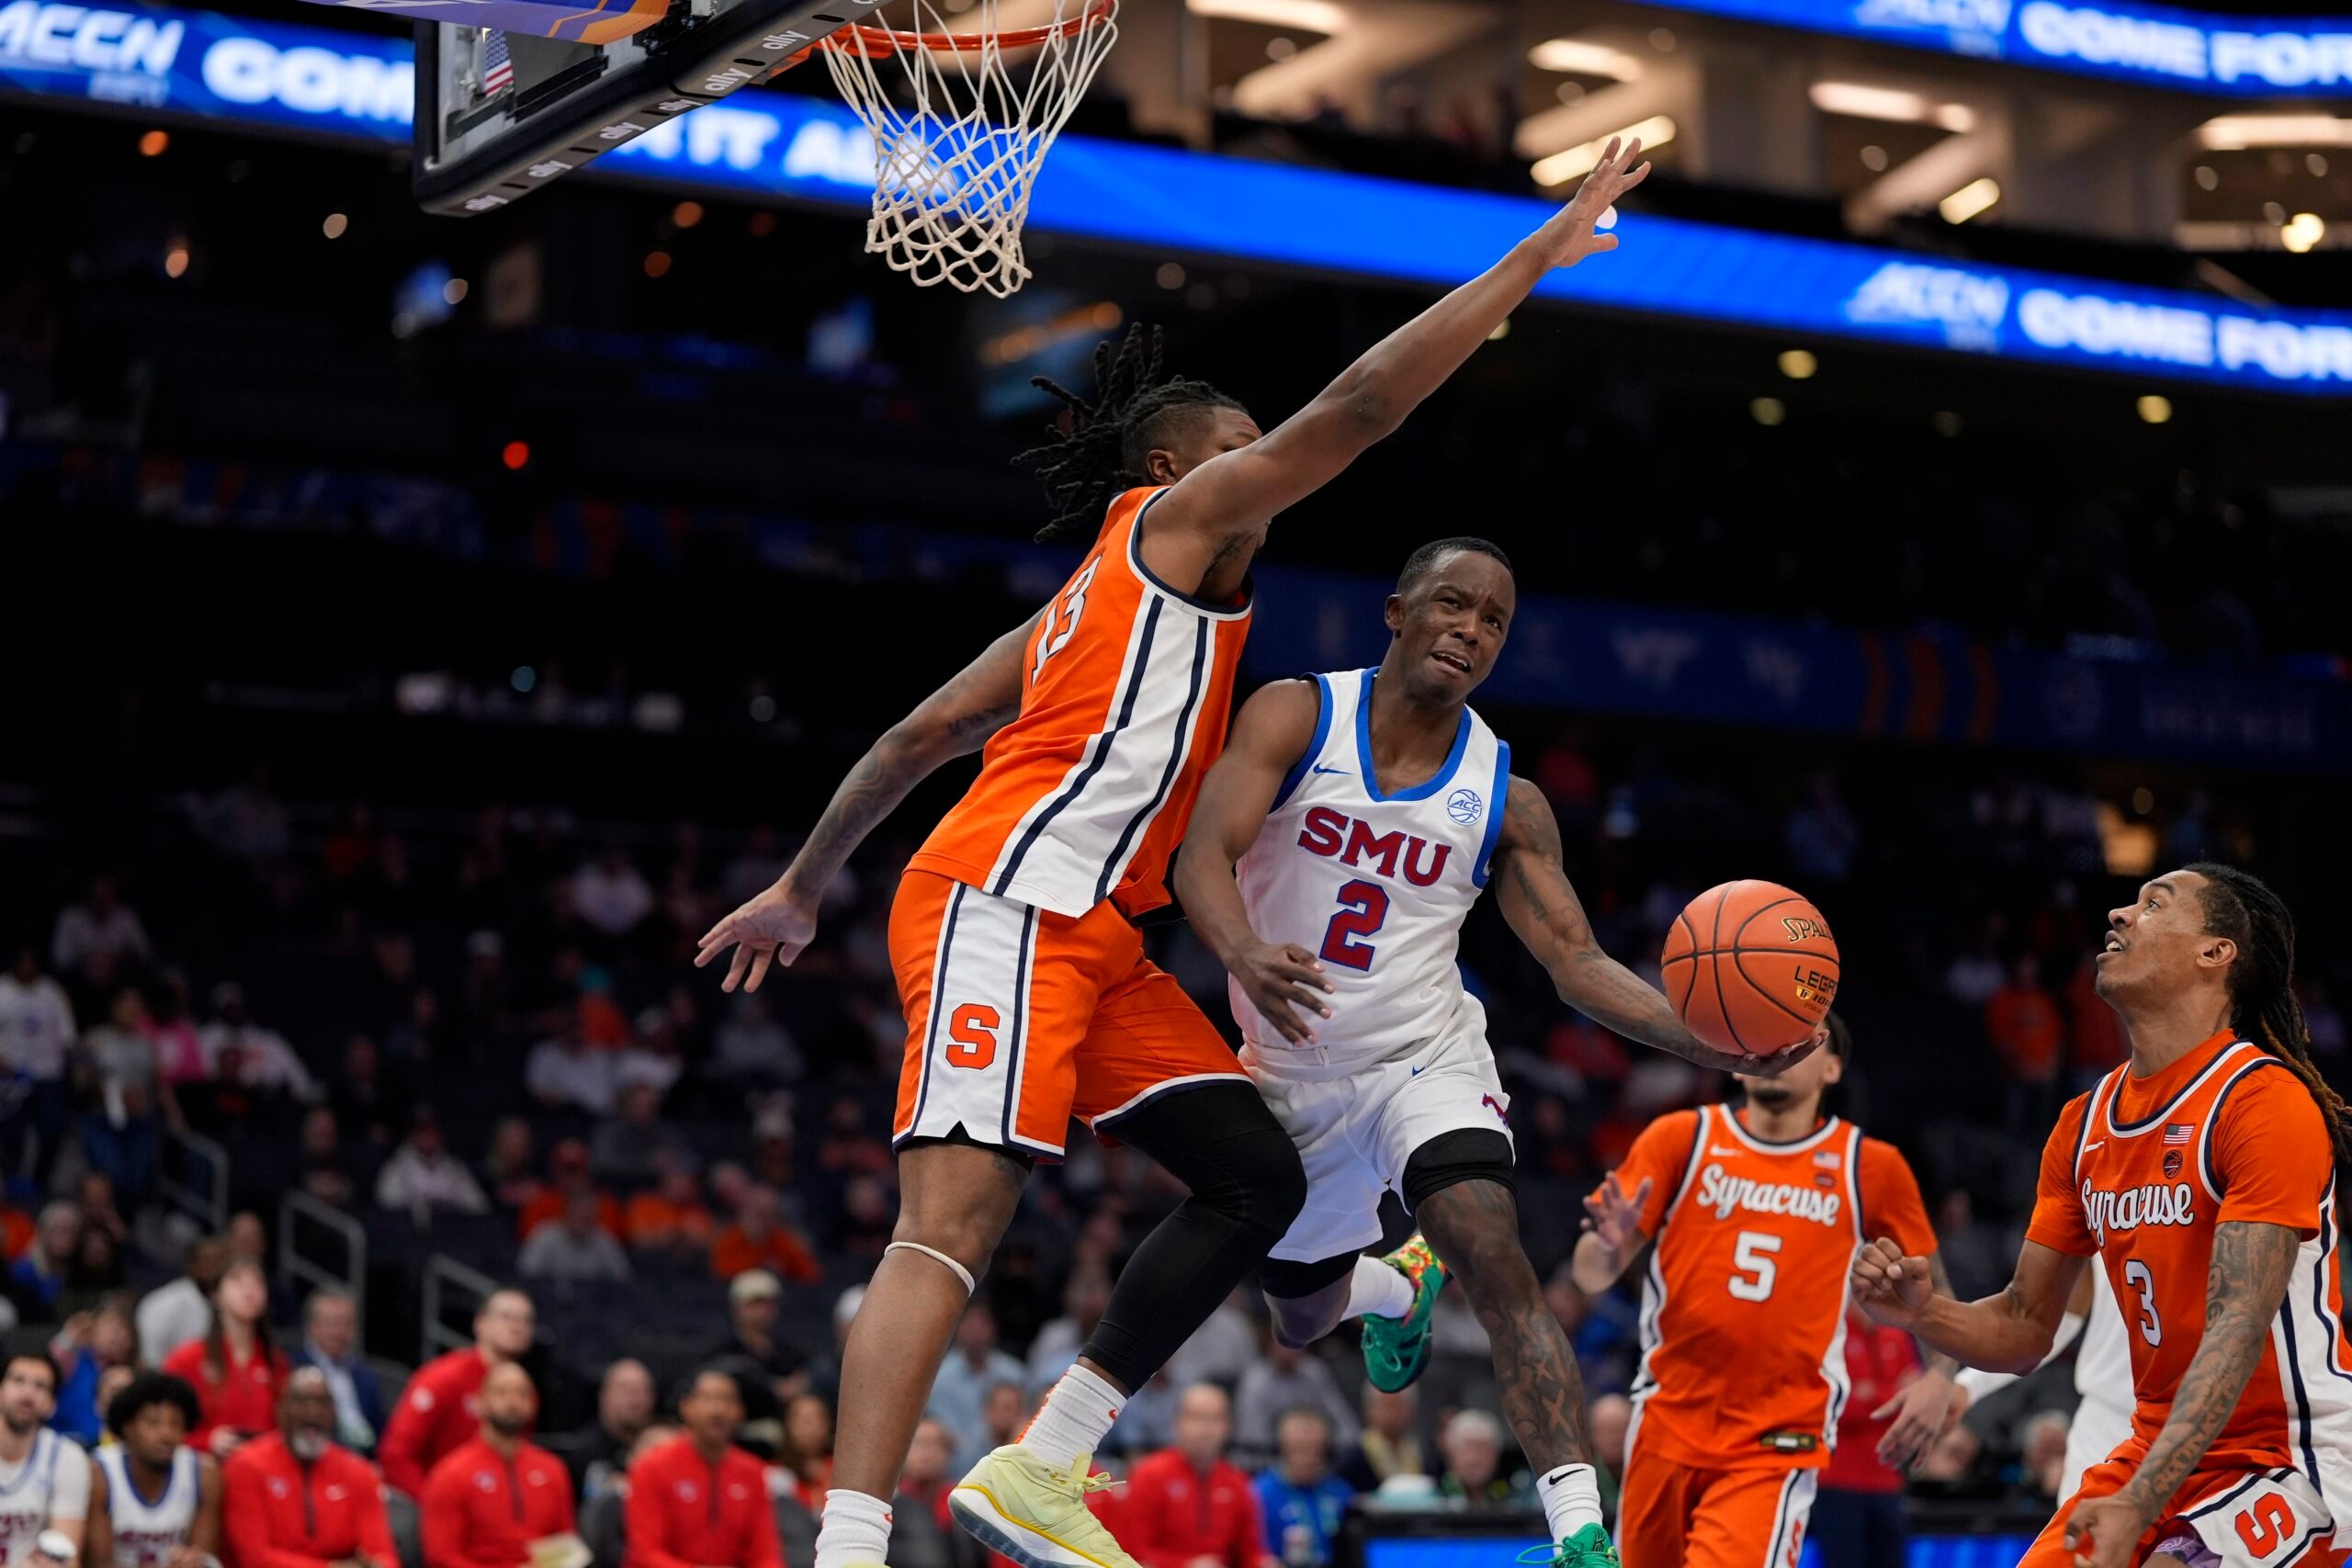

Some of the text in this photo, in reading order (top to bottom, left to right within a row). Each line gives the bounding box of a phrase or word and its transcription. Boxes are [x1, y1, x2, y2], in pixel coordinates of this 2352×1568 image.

[762, 29, 811, 50] ally
[2021, 0, 2205, 79] COME
[201, 35, 413, 125] COM
[658, 99, 704, 111] ally
[704, 67, 753, 91] ally
[599, 122, 646, 140] ally
[528, 160, 573, 178] ally
[2019, 288, 2213, 367] COME
[1031, 555, 1102, 688] 13
[1449, 798, 1483, 814] ACC
[1297, 806, 1452, 886] SMU
[1319, 879, 1390, 972] 2
[945, 1003, 1000, 1070] S
[1696, 1164, 1841, 1227] Syracuse
[1728, 1231, 1782, 1303] 5
[2125, 1258, 2163, 1348] 3
[2234, 1492, 2296, 1559] S
